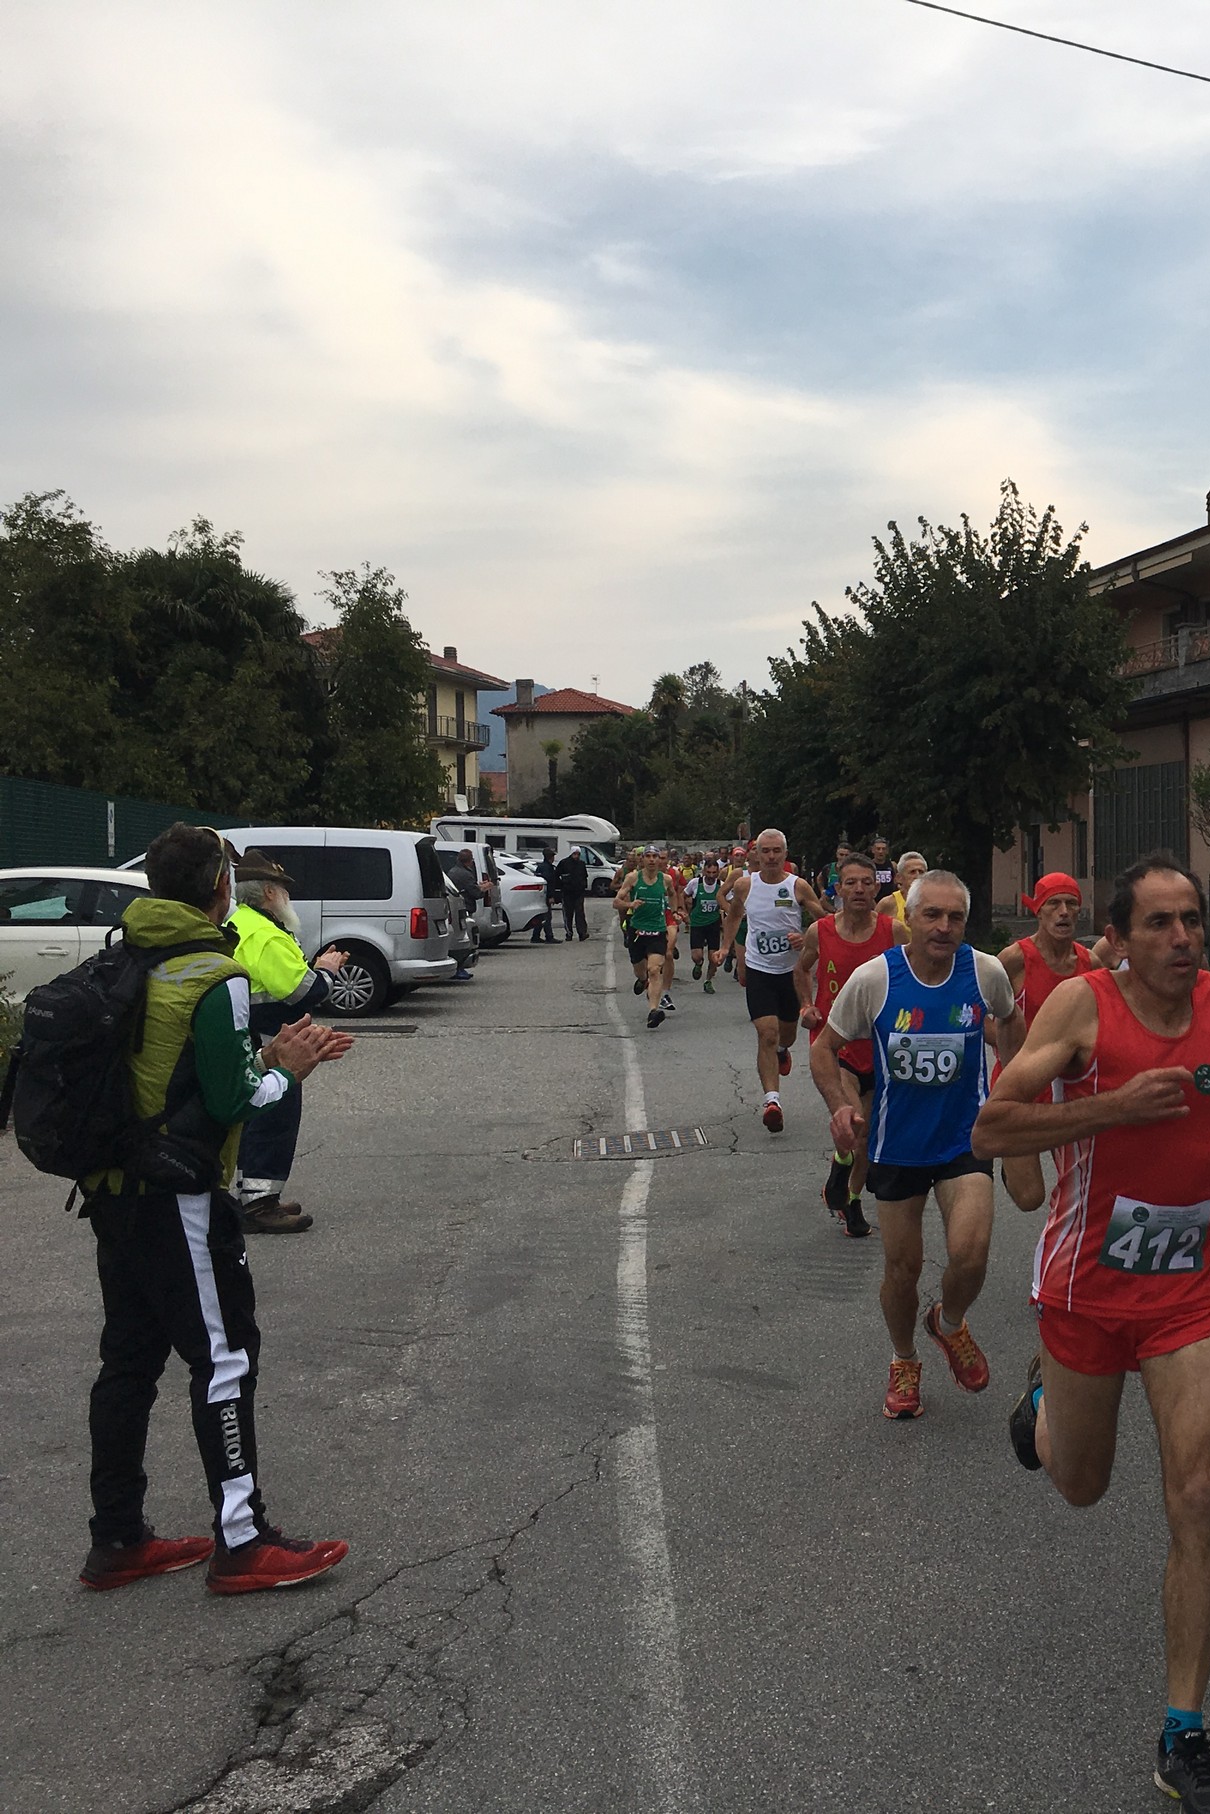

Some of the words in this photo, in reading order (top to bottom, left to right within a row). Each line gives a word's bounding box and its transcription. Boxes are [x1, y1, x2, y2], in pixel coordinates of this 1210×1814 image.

[876, 874, 892, 883] 585
[701, 903, 718, 913] 367
[758, 935, 790, 954] 365
[893, 1045, 957, 1083] 359
[1108, 1225, 1201, 1271] 412
